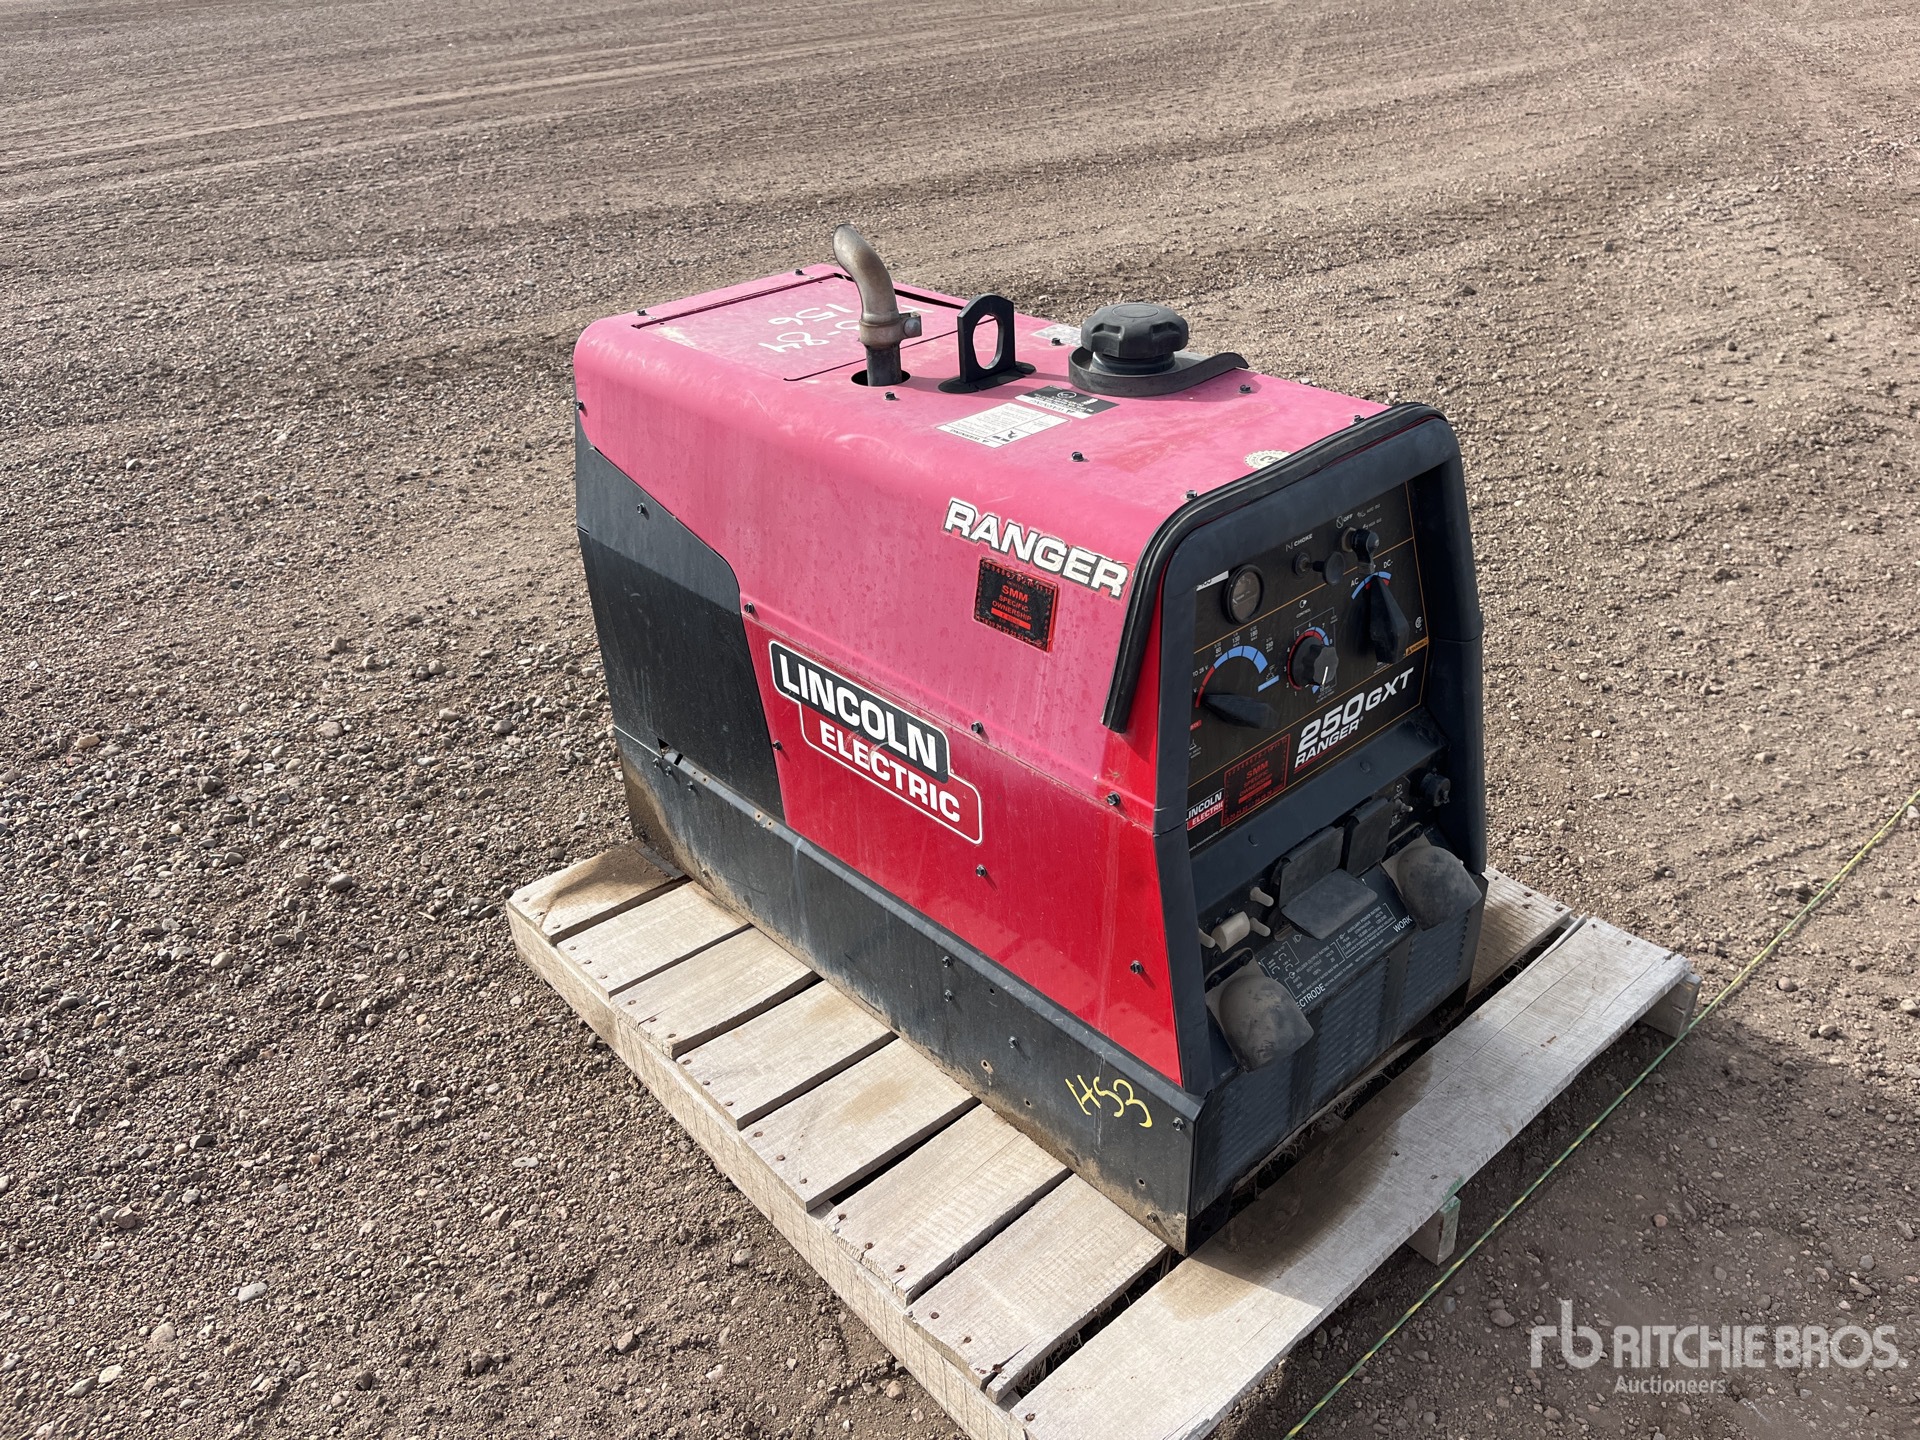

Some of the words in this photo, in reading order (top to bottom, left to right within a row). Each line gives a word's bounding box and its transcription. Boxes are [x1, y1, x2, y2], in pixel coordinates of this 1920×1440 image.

[944, 500, 1129, 600] RANGER
[1294, 534, 1313, 547] CHOKE
[1002, 585, 1028, 603] SMM
[1351, 578, 1359, 587] AC
[992, 601, 1032, 620] OWNERSHIP
[999, 595, 1029, 612] SPECIFIC
[779, 653, 938, 772] LINCOLN
[1298, 693, 1364, 753] 250
[1365, 667, 1414, 711] GXT
[1295, 719, 1359, 768] RANGER
[819, 719, 961, 823] ELECTRIC
[1246, 760, 1269, 779] SMM
[1186, 791, 1222, 821] INCOLN
[1392, 914, 1413, 933] WORK
[1297, 983, 1326, 1010] ECTRODE
